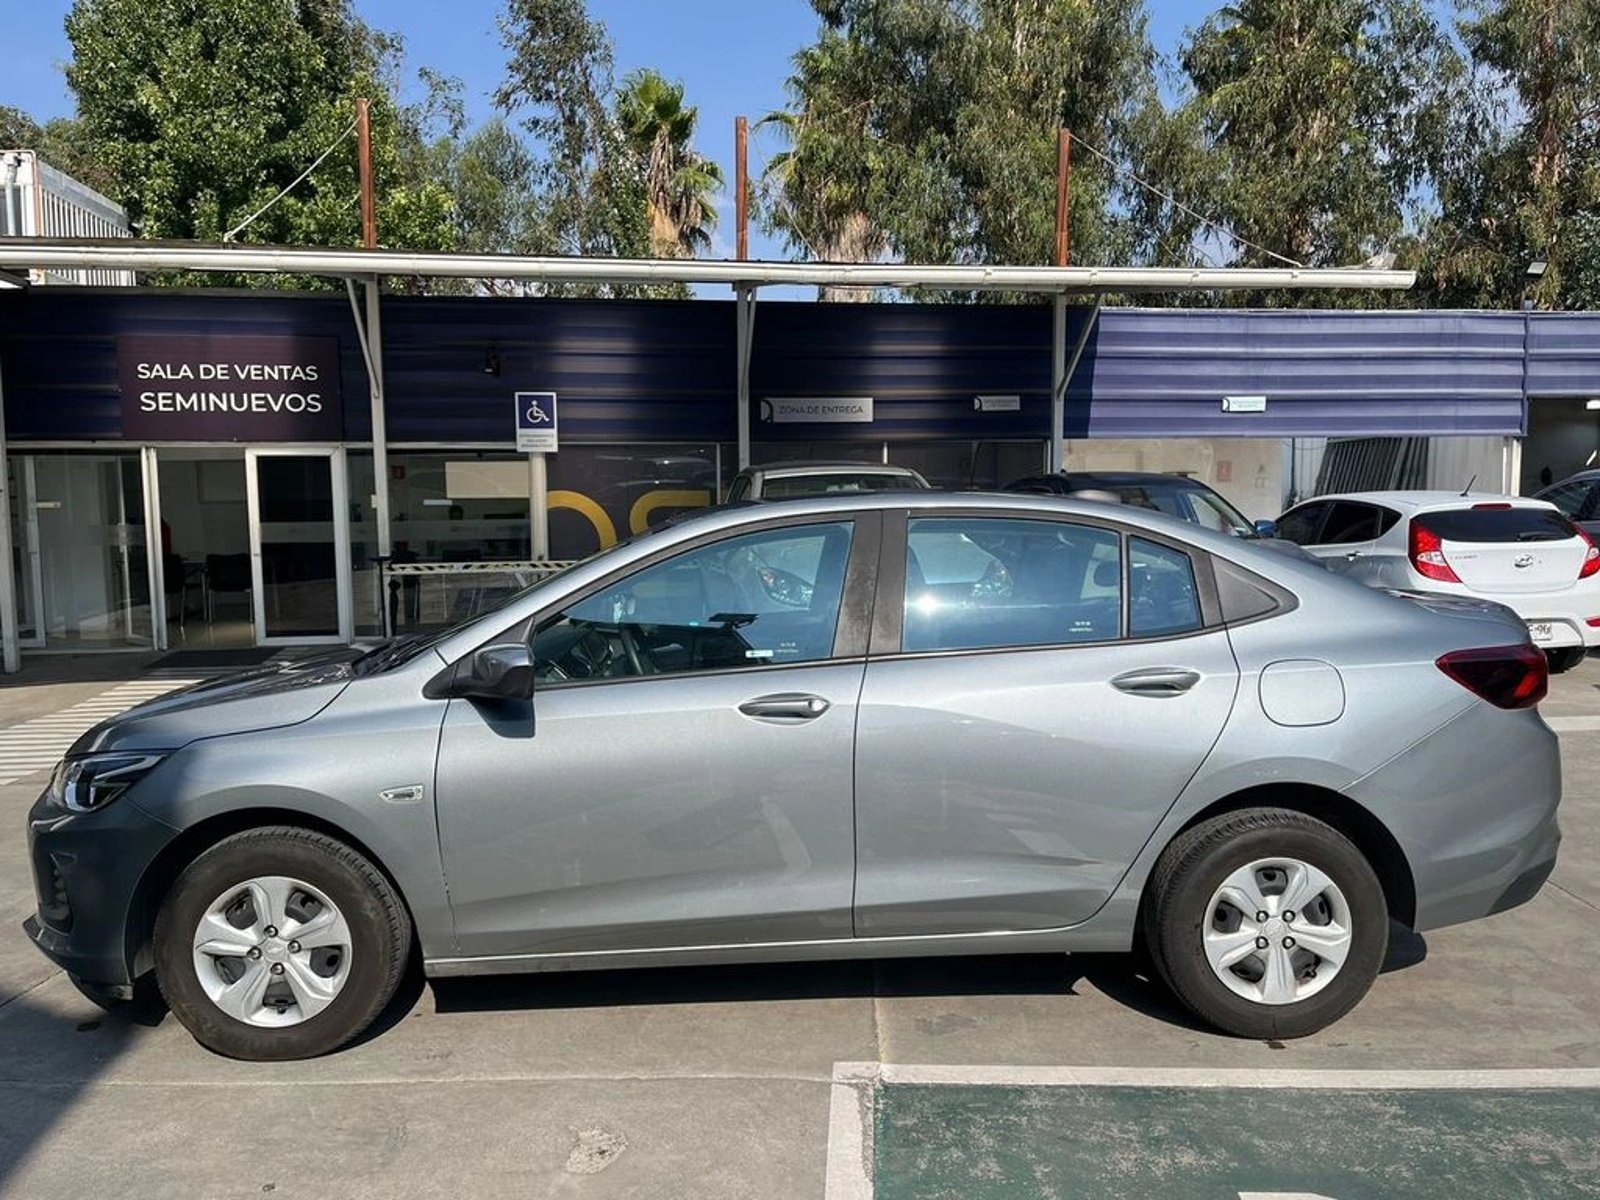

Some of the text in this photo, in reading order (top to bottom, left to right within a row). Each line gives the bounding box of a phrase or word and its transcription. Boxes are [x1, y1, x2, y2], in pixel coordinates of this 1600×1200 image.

[136, 363, 318, 381] SALA DE VENTAS
[140, 391, 322, 413] SEMINUEVOS
[778, 405, 864, 415] ZONA DE ENTREGA
